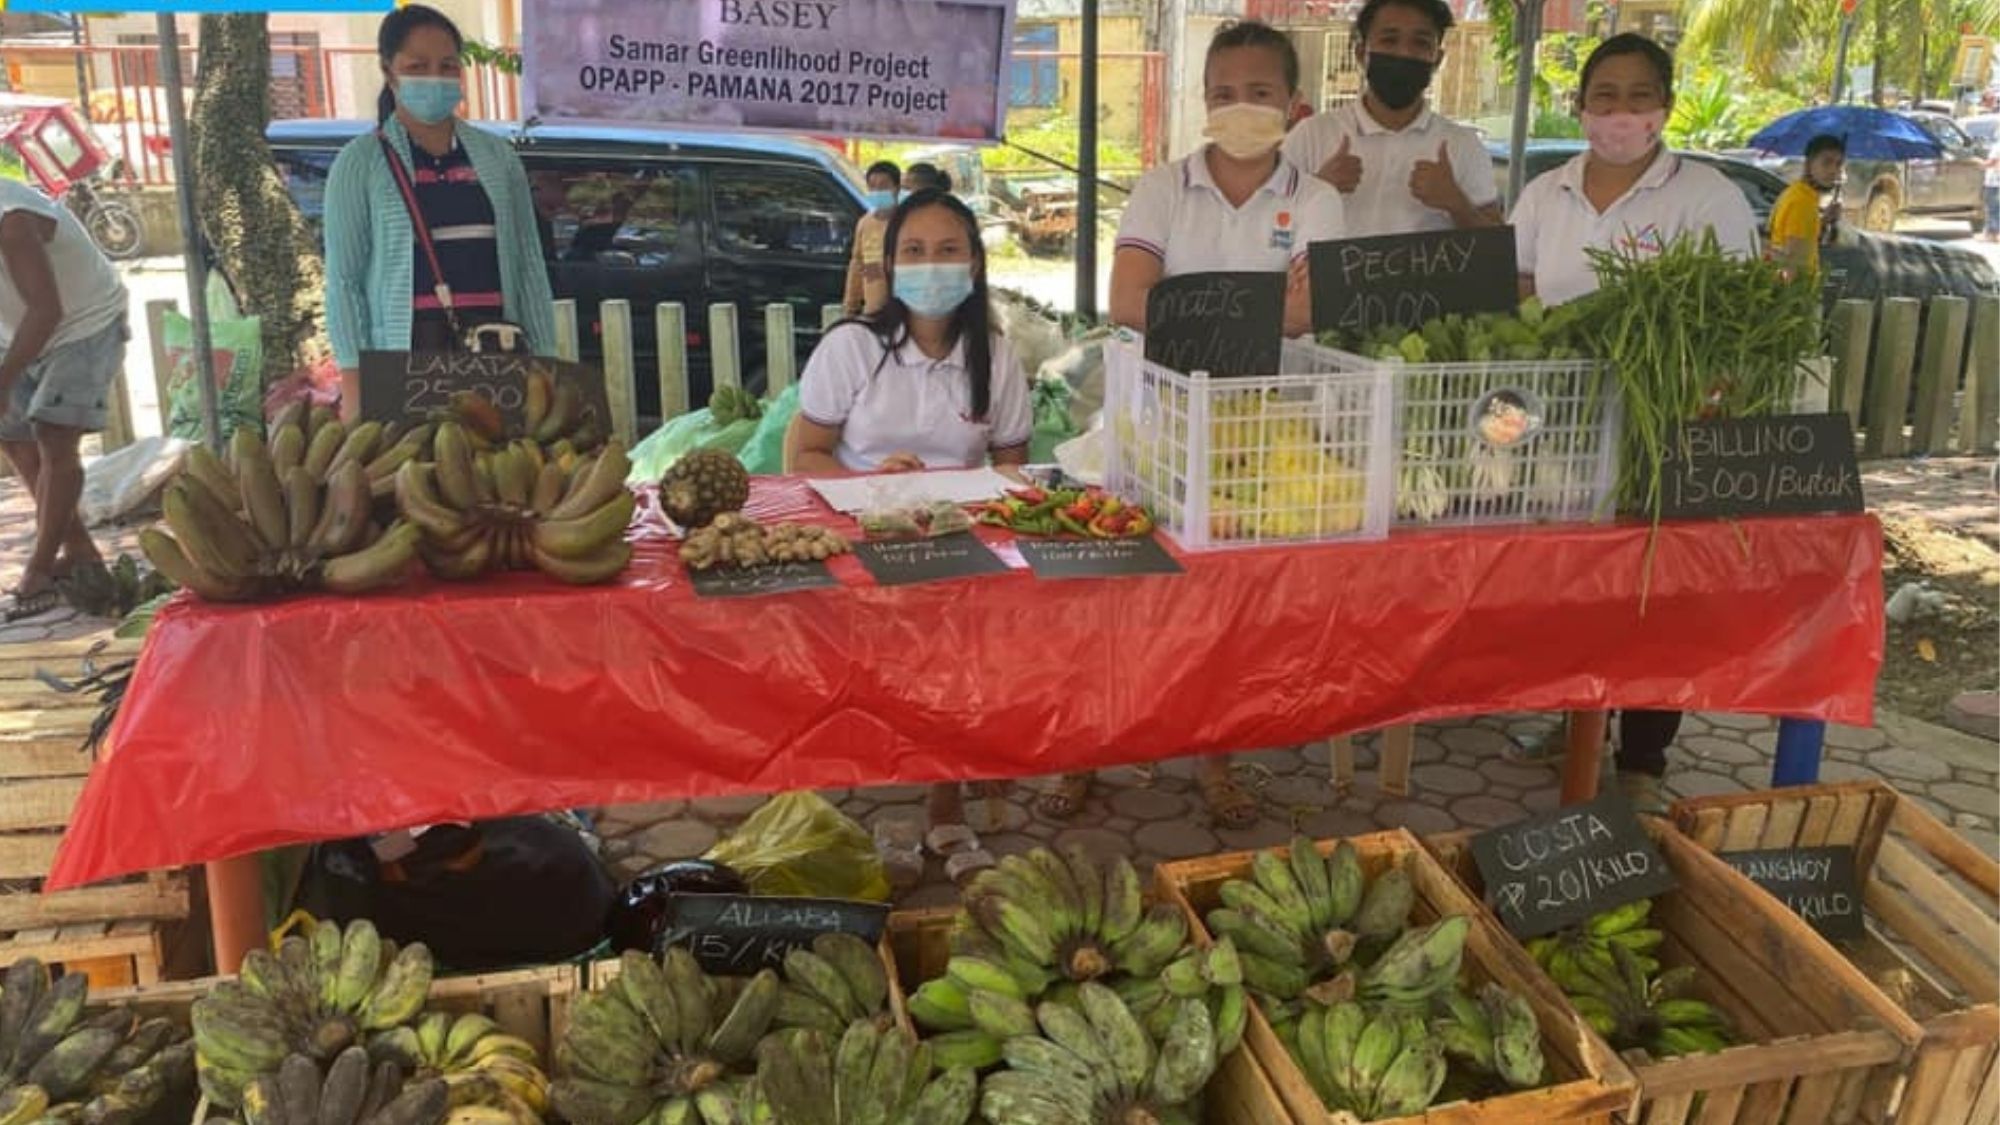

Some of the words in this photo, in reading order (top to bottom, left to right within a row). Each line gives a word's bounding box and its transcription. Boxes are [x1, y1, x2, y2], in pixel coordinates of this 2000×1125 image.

[720, 0, 838, 30] BASEY
[609, 34, 690, 63] Samar
[697, 40, 841, 74] Greenlihood
[848, 51, 930, 82] Project
[579, 65, 666, 95] OPAPP
[687, 72, 793, 104] PAMANA
[800, 78, 860, 105] 2017
[867, 83, 949, 115] Project
[1339, 237, 1477, 286] PECHAY
[1498, 813, 1613, 871] COSTA
